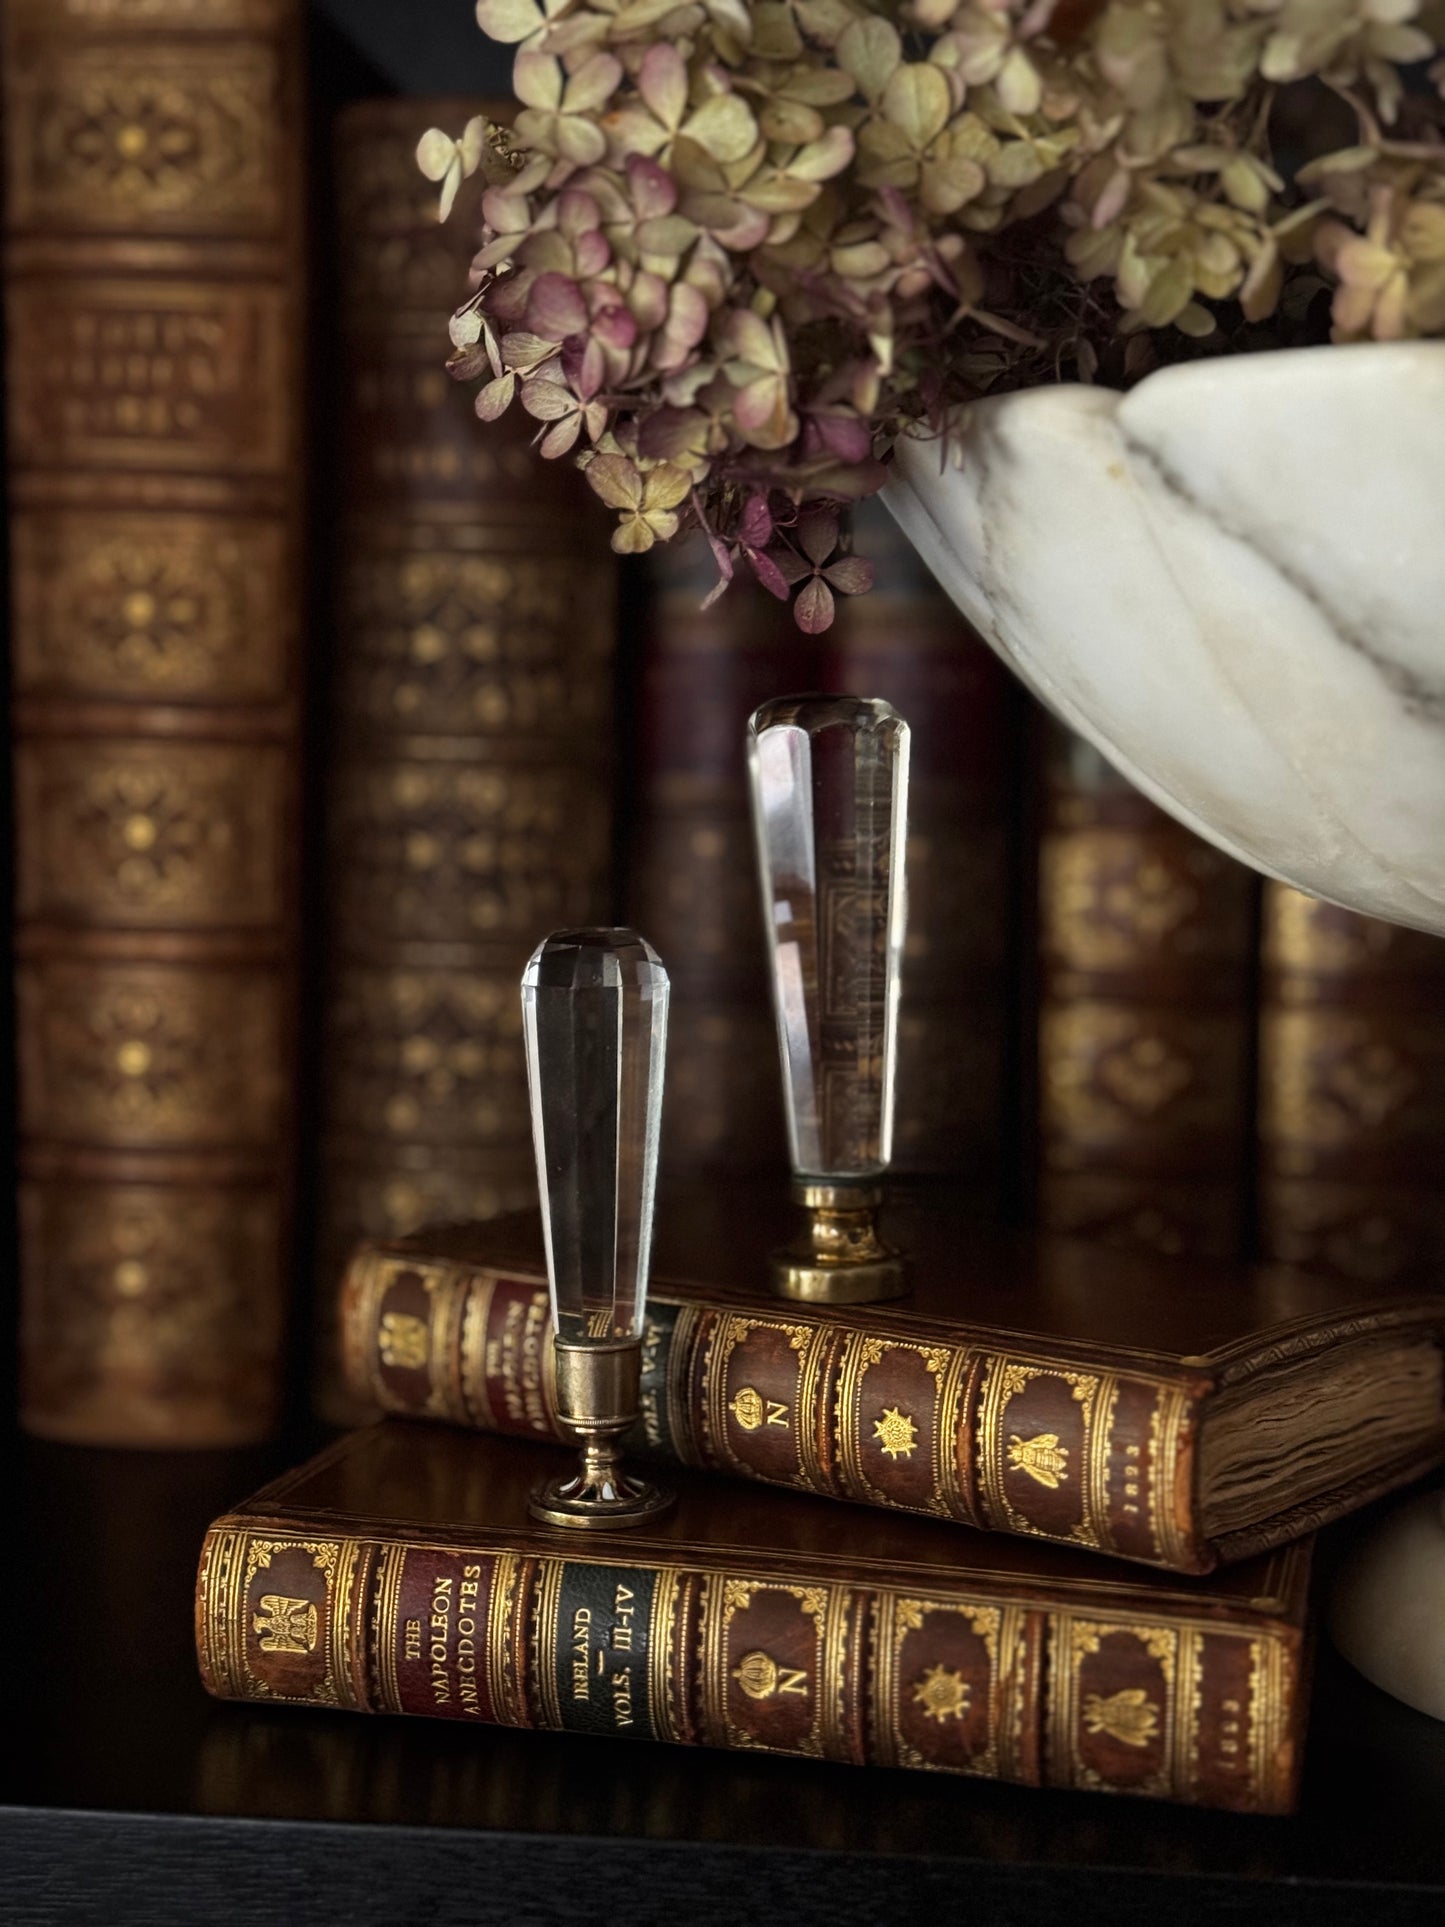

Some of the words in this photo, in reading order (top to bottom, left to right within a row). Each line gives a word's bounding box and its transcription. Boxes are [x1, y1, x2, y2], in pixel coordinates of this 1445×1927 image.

[767, 1400, 790, 1428] N
[404, 1619, 421, 1661] THE
[431, 1577, 453, 1704] NAPOLEON
[457, 1564, 481, 1715] ANECDOTES
[613, 1584, 635, 1651] III-IV
[573, 1607, 591, 1700] IRELAND
[778, 1666, 808, 1696] N
[612, 1666, 634, 1727] VOLS.
